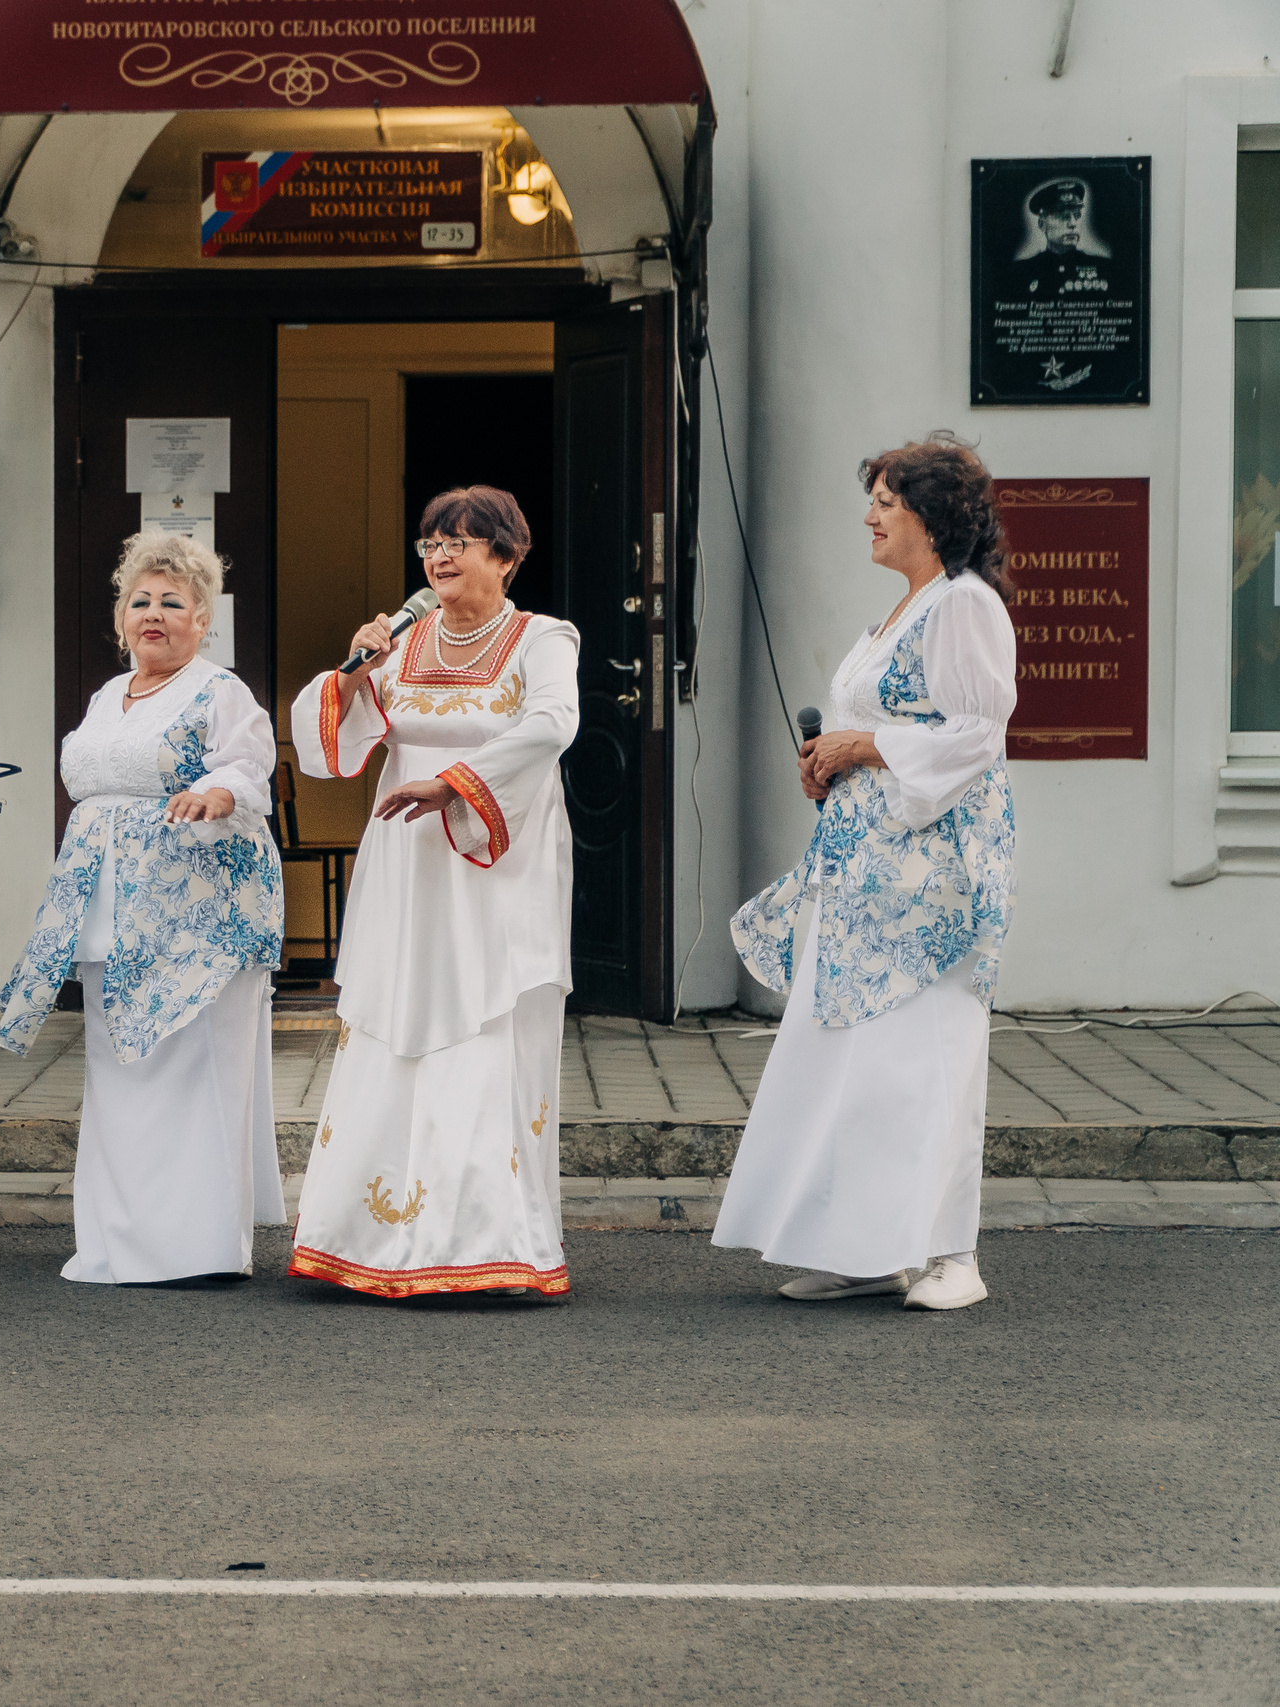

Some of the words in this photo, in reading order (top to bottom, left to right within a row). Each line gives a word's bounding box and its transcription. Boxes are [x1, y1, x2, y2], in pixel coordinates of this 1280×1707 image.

[52, 20, 275, 38] НОВОТИТАРОВСКОГО
[280, 18, 402, 37] СЕЛЬСКОГО
[407, 16, 537, 36] ПОСЕЛЕНИЯ
[302, 159, 440, 176] УЧАСТКОВАЯ
[279, 180, 463, 198] ИЗБИРАТЕЛЬНАЯ
[310, 201, 431, 218] КОМИССИЯ
[212, 230, 334, 245] ИЗБИРАТЕЛЬНОГО
[339, 229, 398, 244] УЧАСТКА
[1010, 552, 1120, 569] ОМНИТЕ!
[1008, 589, 1055, 606] РЕЗ
[1063, 589, 1129, 608] ВЕКА,
[1056, 626, 1122, 644] ГОДА,
[1016, 662, 1120, 680] ОМНИТЕ!
